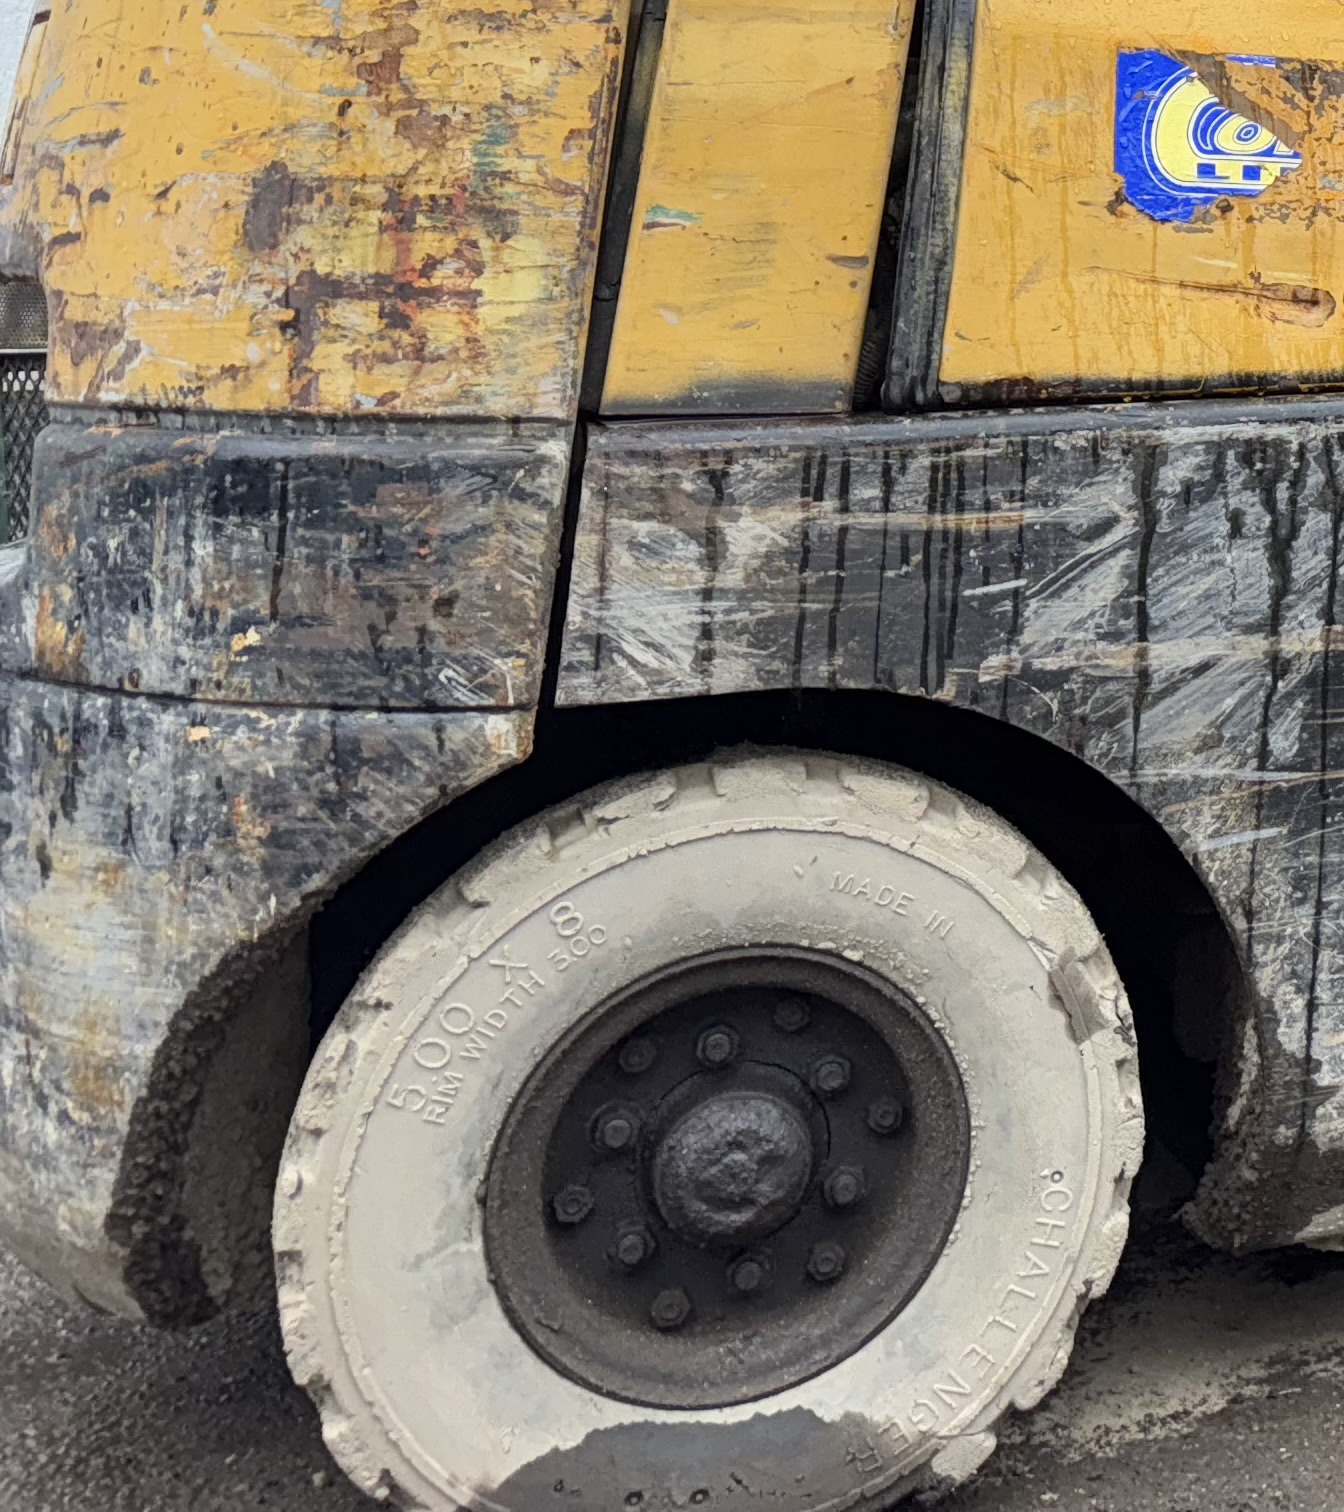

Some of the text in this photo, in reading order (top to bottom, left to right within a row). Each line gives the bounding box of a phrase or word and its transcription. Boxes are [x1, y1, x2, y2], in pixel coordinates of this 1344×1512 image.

[550, 901, 584, 937] 8
[830, 871, 955, 937] MADE IN
[422, 1071, 464, 1125] RIM
[459, 970, 546, 1061] WIDTH
[846, 1187, 1074, 1474] CHALLENGER
